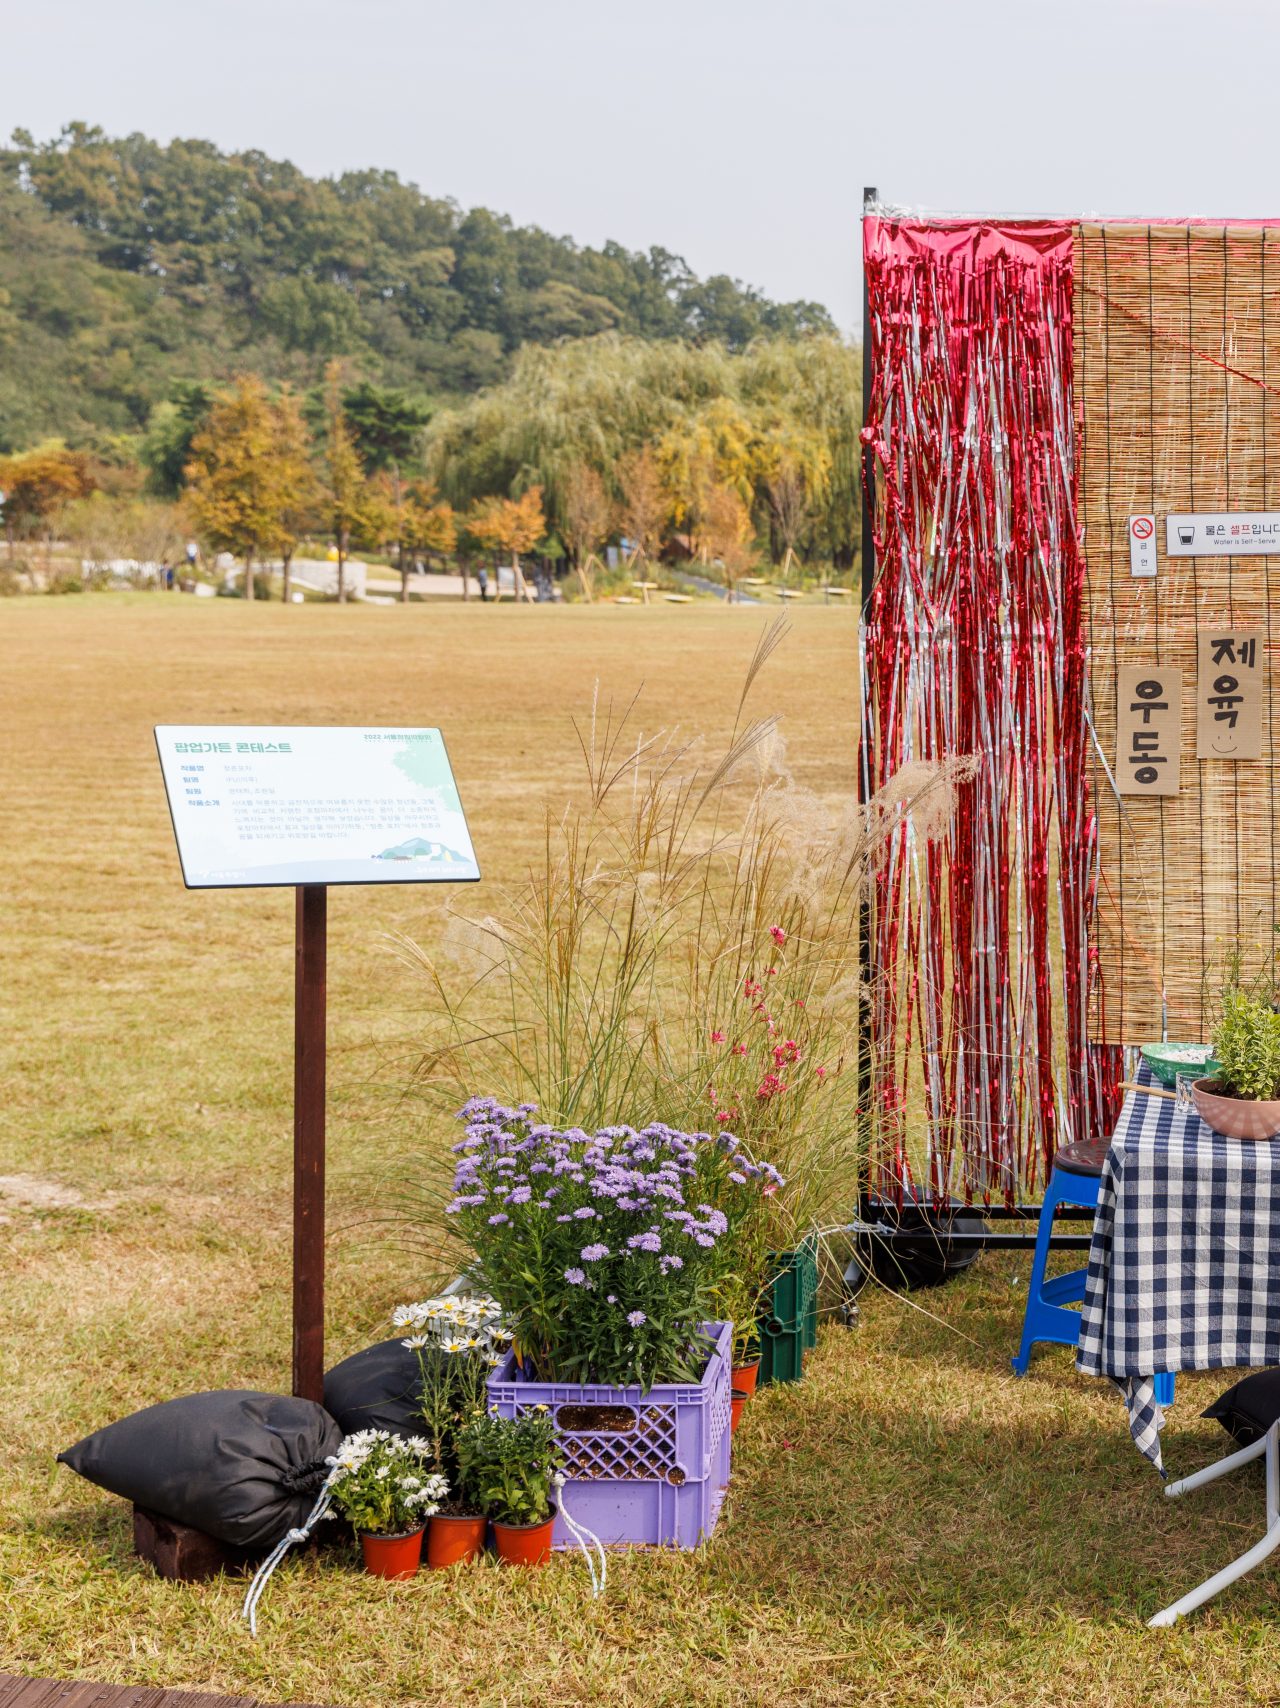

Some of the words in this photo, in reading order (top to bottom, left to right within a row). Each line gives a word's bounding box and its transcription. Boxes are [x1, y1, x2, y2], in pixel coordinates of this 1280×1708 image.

[1206, 525, 1225, 535] 물은
[1213, 538, 1233, 546] Water
[1208, 638, 1255, 728] 제육
[1129, 680, 1168, 783] 우동
[175, 743, 231, 753] 팝업가든
[236, 743, 292, 752] 콘테스트
